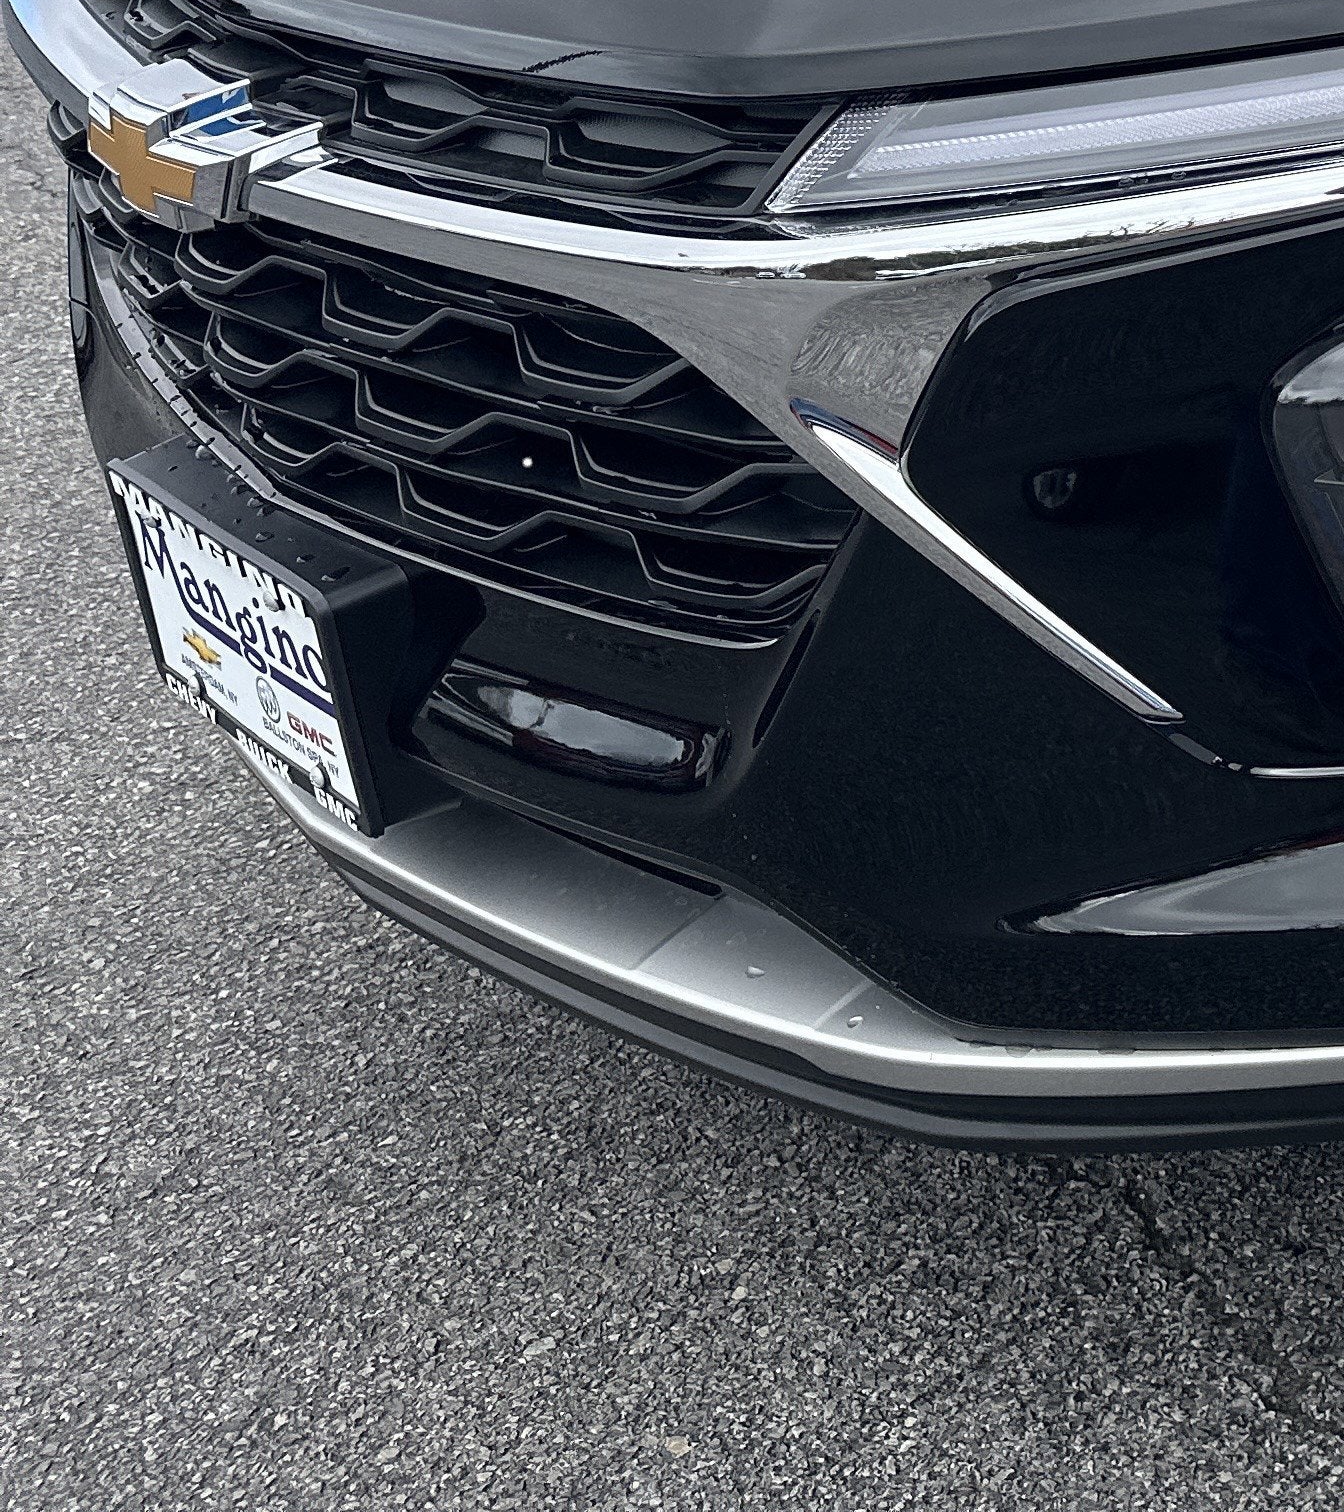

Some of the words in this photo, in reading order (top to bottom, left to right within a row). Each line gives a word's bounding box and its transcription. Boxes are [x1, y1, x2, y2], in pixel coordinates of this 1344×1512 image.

[109, 470, 306, 619] MANGINO
[135, 510, 331, 693] Mangino
[166, 674, 217, 726] CHEVY
[235, 728, 294, 785] BUICK
[262, 716, 306, 756] BALLSTON
[287, 710, 337, 757] GMC
[313, 786, 358, 832] GMC
